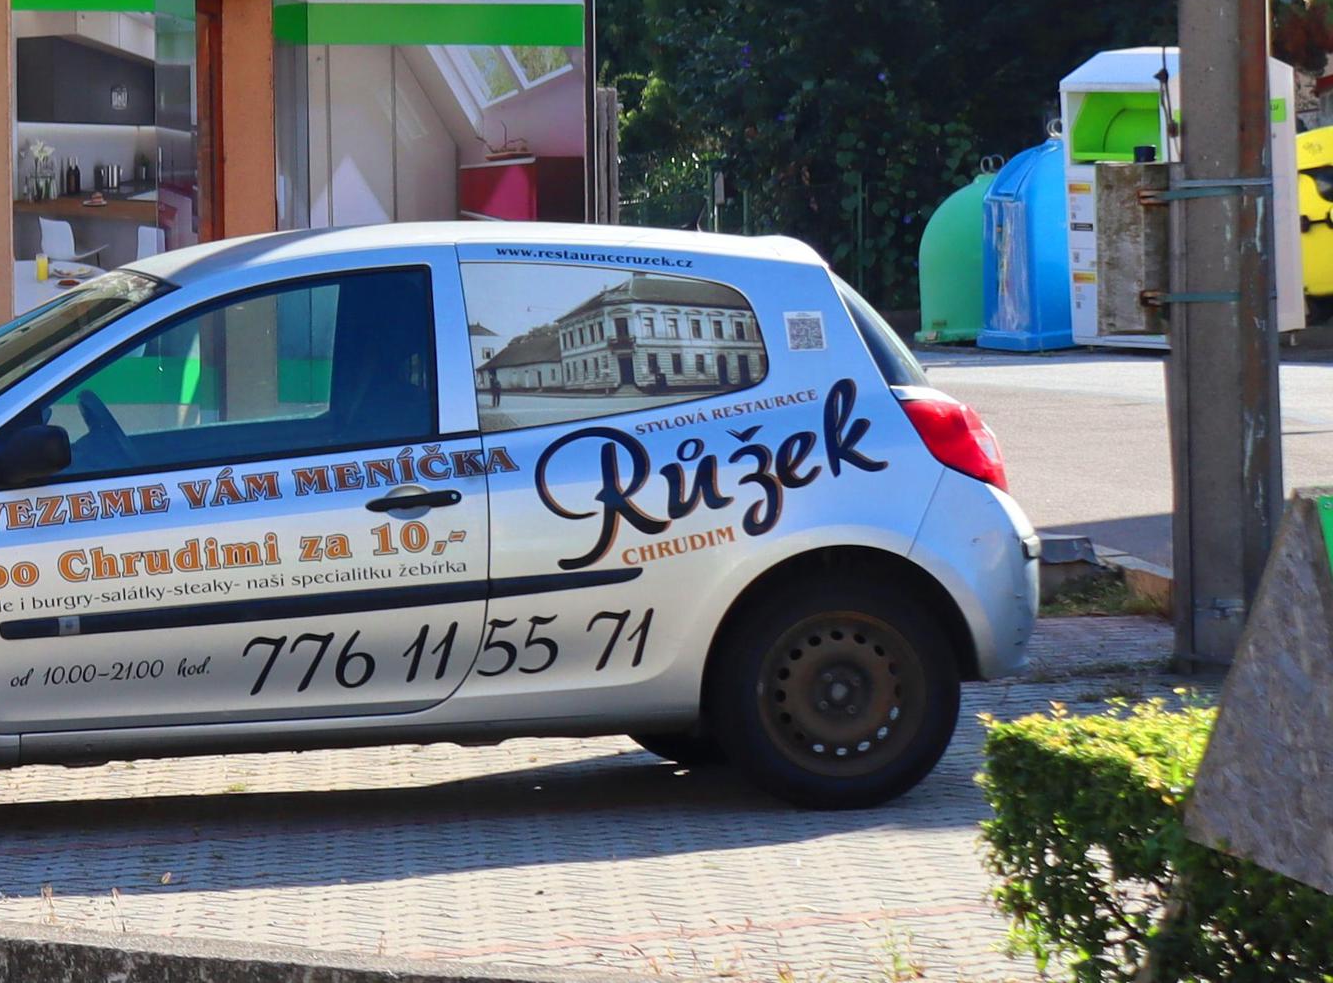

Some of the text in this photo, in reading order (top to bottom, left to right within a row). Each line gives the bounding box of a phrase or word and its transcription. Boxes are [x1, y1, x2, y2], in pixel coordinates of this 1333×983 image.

[496, 246, 693, 269] www.restauraceruzek.cz
[635, 389, 819, 436] STYLOVÁ RESTAURACE
[178, 466, 283, 509] VÁM
[291, 444, 520, 496] MENÍČKA
[535, 378, 889, 570] Růžek
[57, 532, 282, 582] Chrudimi
[299, 534, 353, 562] za
[371, 521, 467, 556] 10,-
[621, 526, 737, 566] CHRUDIM
[20, 597, 25, 611] i
[246, 574, 285, 591] naši
[291, 567, 392, 588] specialitku
[399, 560, 467, 577] žebírka
[10, 656, 211, 688] od 10.00-21.00 hod.
[242, 607, 655, 696] 776 11 55 71
